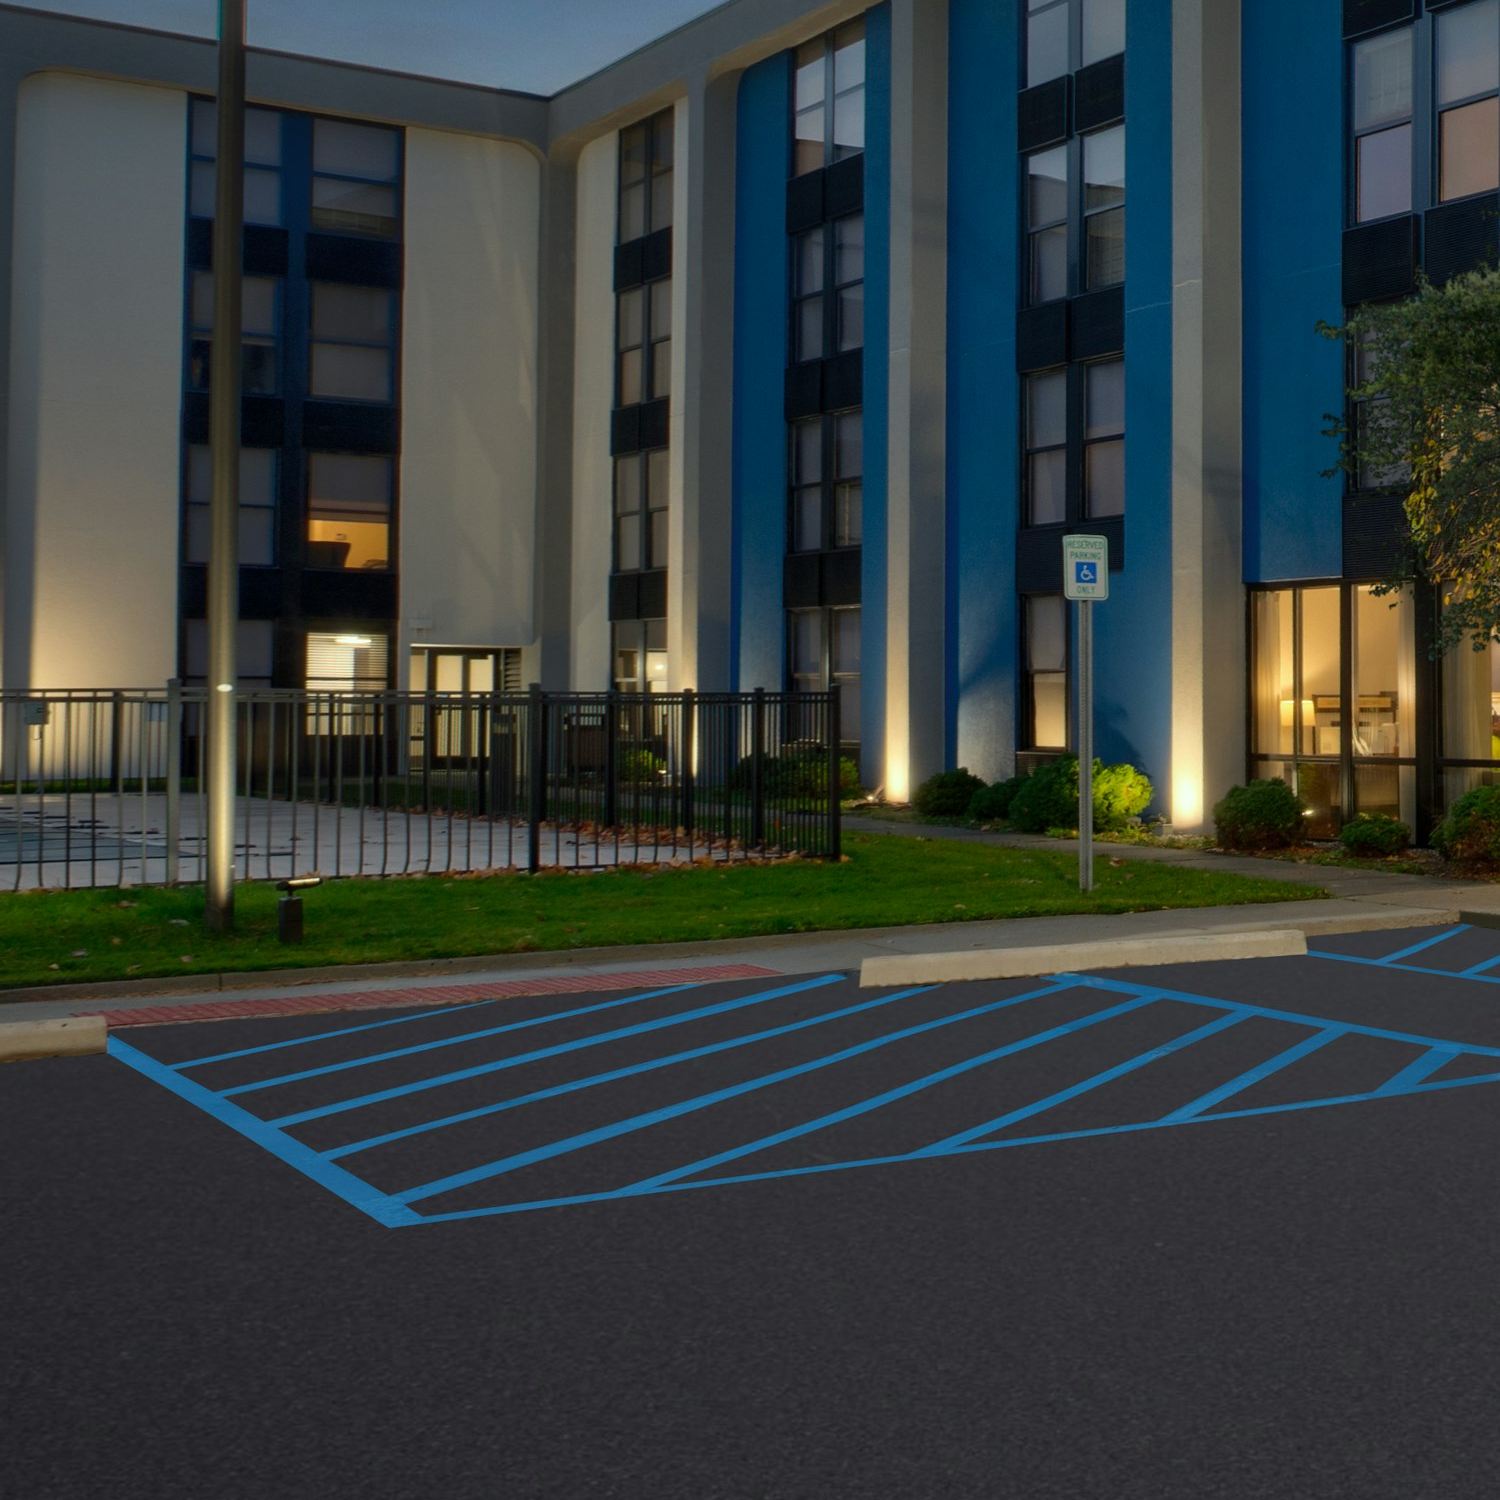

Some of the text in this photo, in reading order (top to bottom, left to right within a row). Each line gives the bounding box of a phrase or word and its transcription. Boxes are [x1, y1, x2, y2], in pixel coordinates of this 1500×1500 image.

[1067, 539, 1104, 550] RESERVED
[1070, 551, 1102, 560] PARKING
[1076, 585, 1095, 594] ONLY
